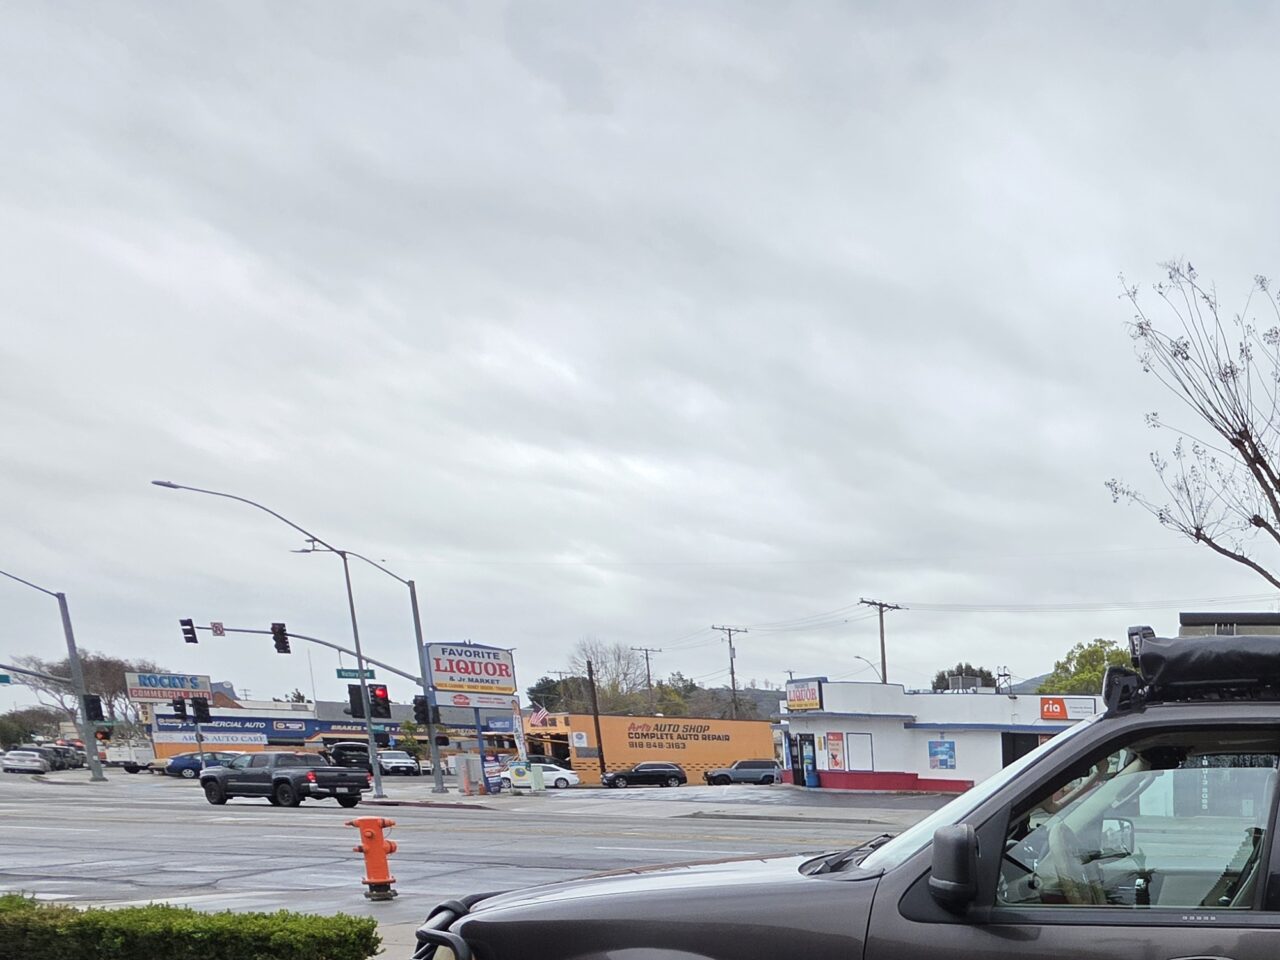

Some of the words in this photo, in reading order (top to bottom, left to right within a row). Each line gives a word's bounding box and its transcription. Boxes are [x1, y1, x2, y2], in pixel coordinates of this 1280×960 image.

[441, 647, 500, 660] FAVORITE
[433, 657, 512, 677] LIQUOR
[138, 674, 199, 689] ROCKY'S
[467, 677, 500, 685] MARKET
[132, 688, 185, 699] COMMERCIAL
[188, 690, 209, 699] AUTO
[1043, 700, 1061, 713] ria
[243, 721, 266, 729] AUTO
[652, 723, 681, 733] AUTO
[682, 724, 711, 734] SHOP
[627, 732, 674, 740] COMPLETE
[676, 733, 700, 741] AUTO
[701, 734, 731, 742] REPAIR
